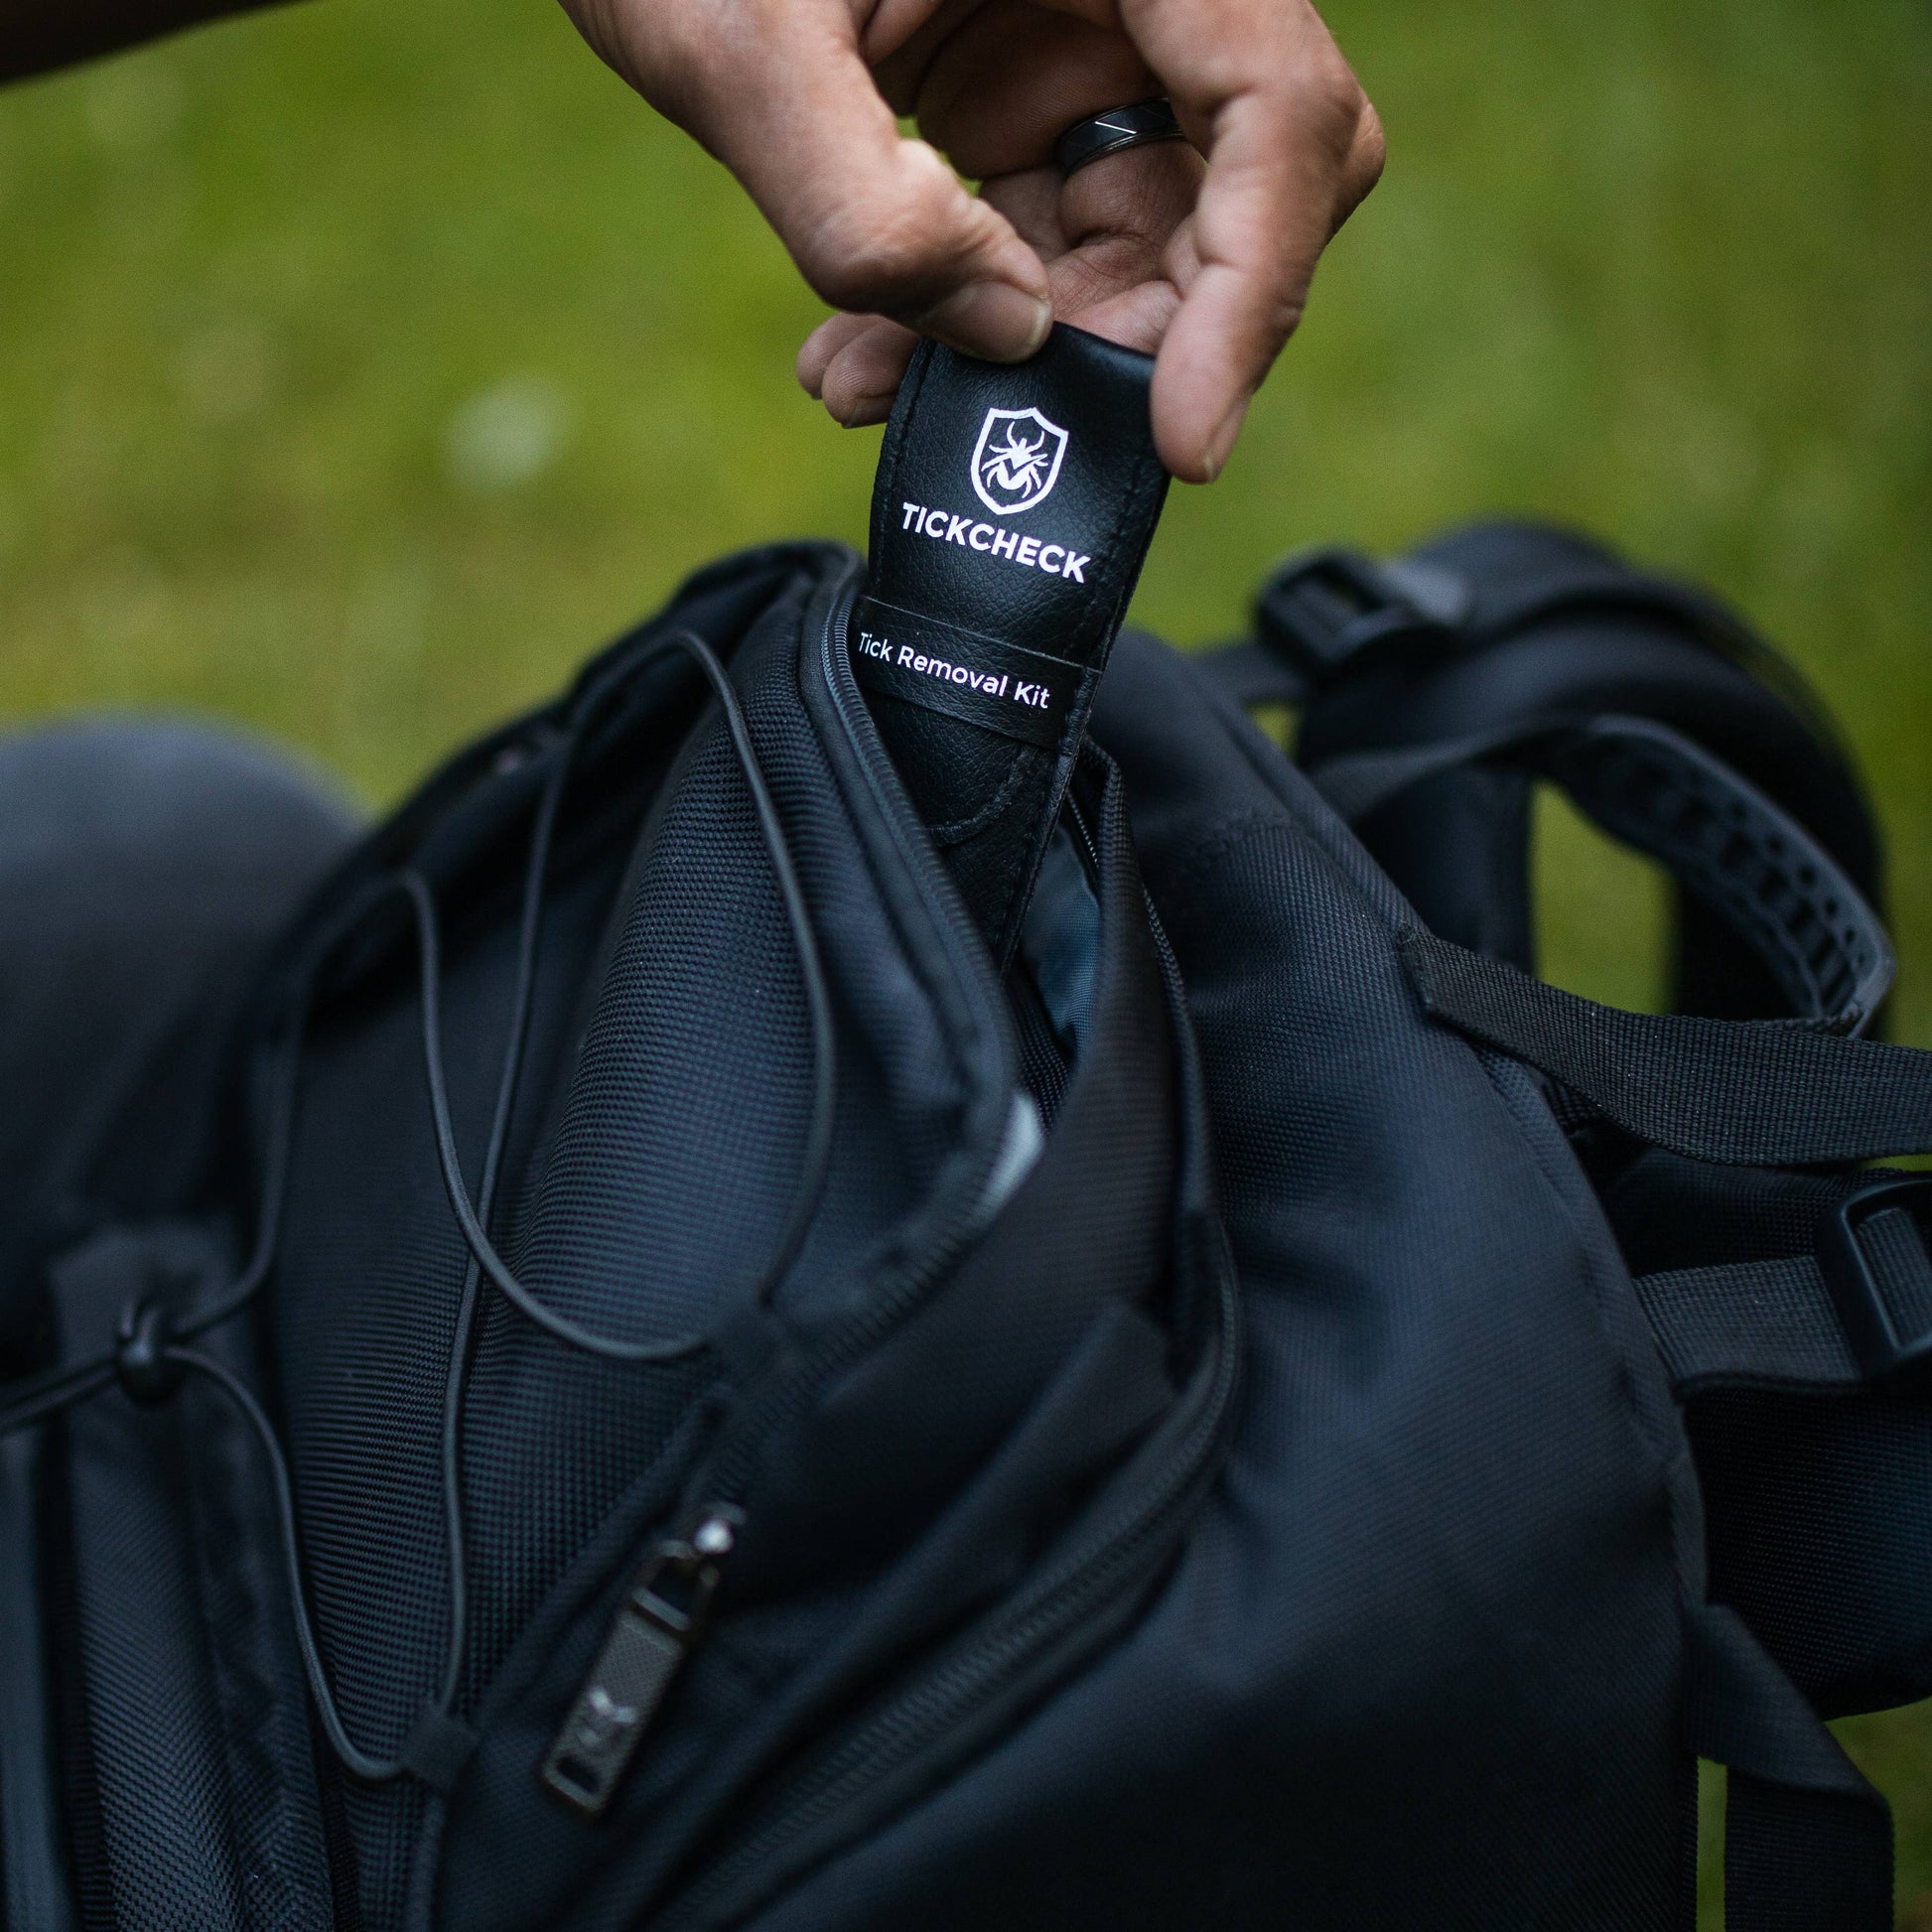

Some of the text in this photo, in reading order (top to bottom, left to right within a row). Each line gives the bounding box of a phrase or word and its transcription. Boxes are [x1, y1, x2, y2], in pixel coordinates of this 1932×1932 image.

[902, 501, 1091, 584] TICKCHECK
[859, 631, 1050, 709] Tick Removal Kit
